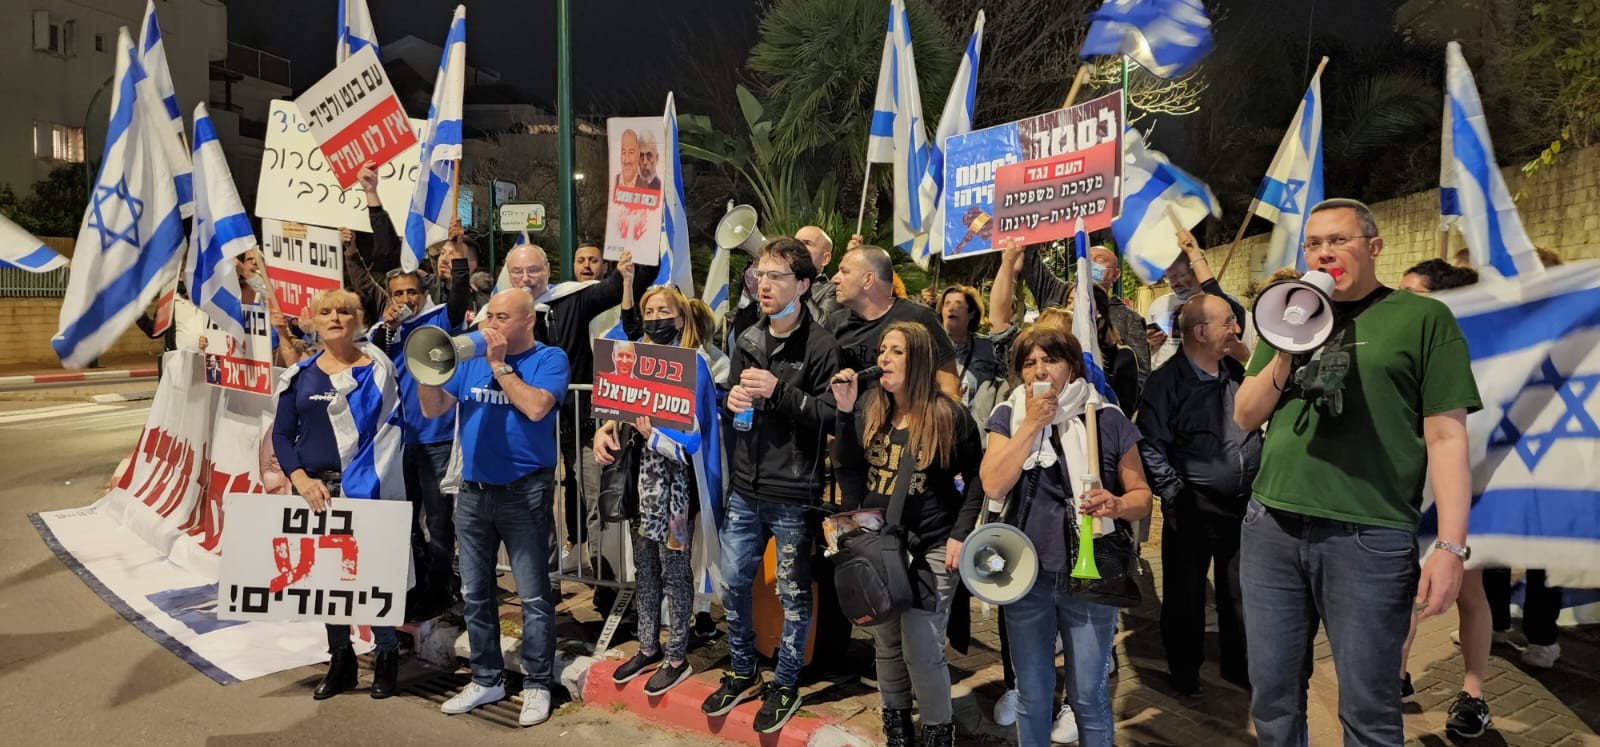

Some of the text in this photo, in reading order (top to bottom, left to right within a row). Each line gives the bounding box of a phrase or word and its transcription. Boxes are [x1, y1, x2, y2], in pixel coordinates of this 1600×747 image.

[308, 64, 383, 128] עם בנט ולפיד-
[361, 124, 386, 155] לנו
[383, 109, 410, 145] אין
[265, 146, 323, 172] טרור
[327, 139, 365, 178] עתיד!
[1027, 158, 1083, 181] העם נגד
[954, 184, 995, 208] קירה!
[1004, 187, 1055, 208] משפטית
[1061, 175, 1104, 197] מערכת
[265, 234, 338, 270] העם דורש-
[223, 358, 270, 390] לישראל
[640, 355, 684, 382] בנט
[597, 377, 691, 416] מסוכן לישראל!
[865, 432, 924, 471] BI
[282, 507, 354, 536] בנט
[269, 534, 359, 593] רע
[229, 584, 393, 618] ליהודים!
